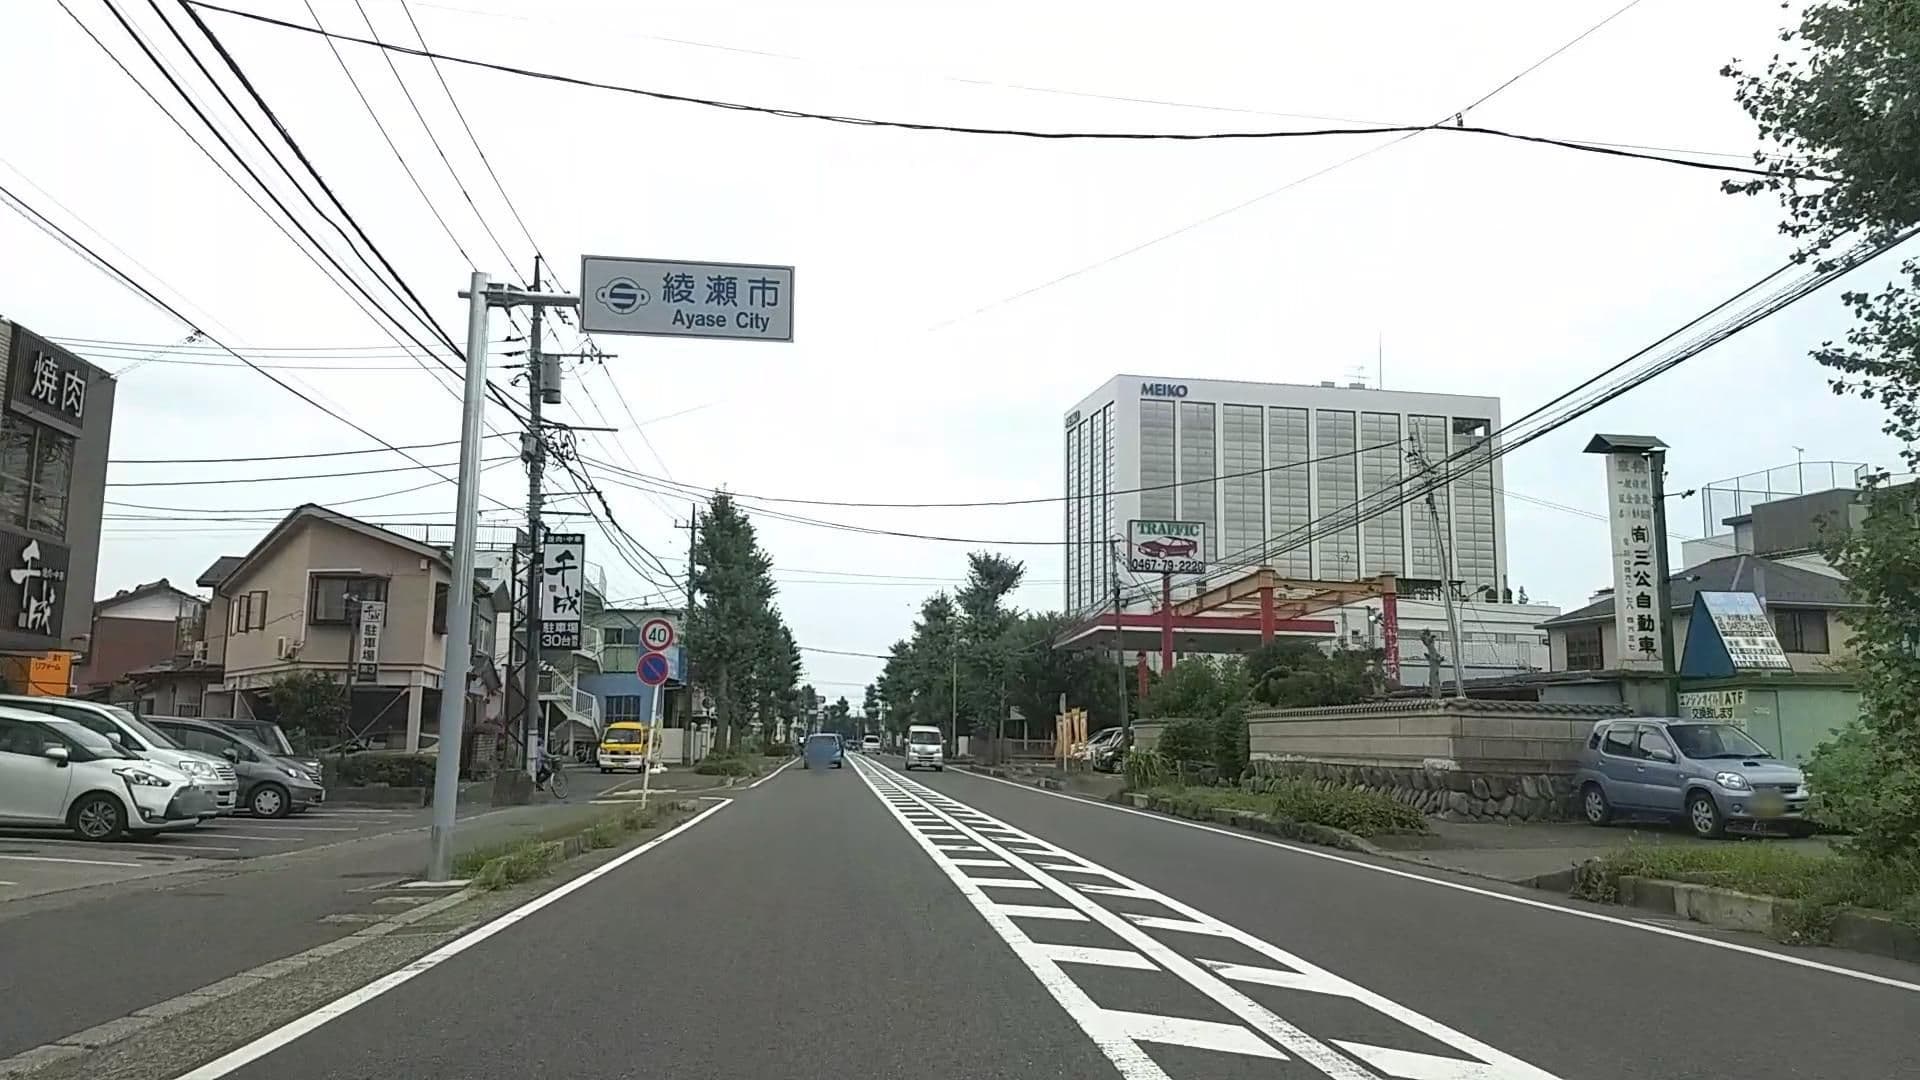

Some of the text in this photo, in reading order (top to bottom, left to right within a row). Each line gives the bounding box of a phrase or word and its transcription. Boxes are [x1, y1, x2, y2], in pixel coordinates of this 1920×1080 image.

[662, 272, 780, 308] 綾瀬市
[672, 309, 769, 332] Ayase City
[31, 351, 86, 418] 焼肉
[1141, 382, 1188, 398] MEIKO
[1137, 522, 1200, 536] TRAFFIC
[11, 539, 56, 636] 千成
[544, 549, 581, 616] 千成
[542, 621, 579, 634] 駐車場
[648, 627, 667, 642] 40
[1725, 691, 1744, 705] ATF
